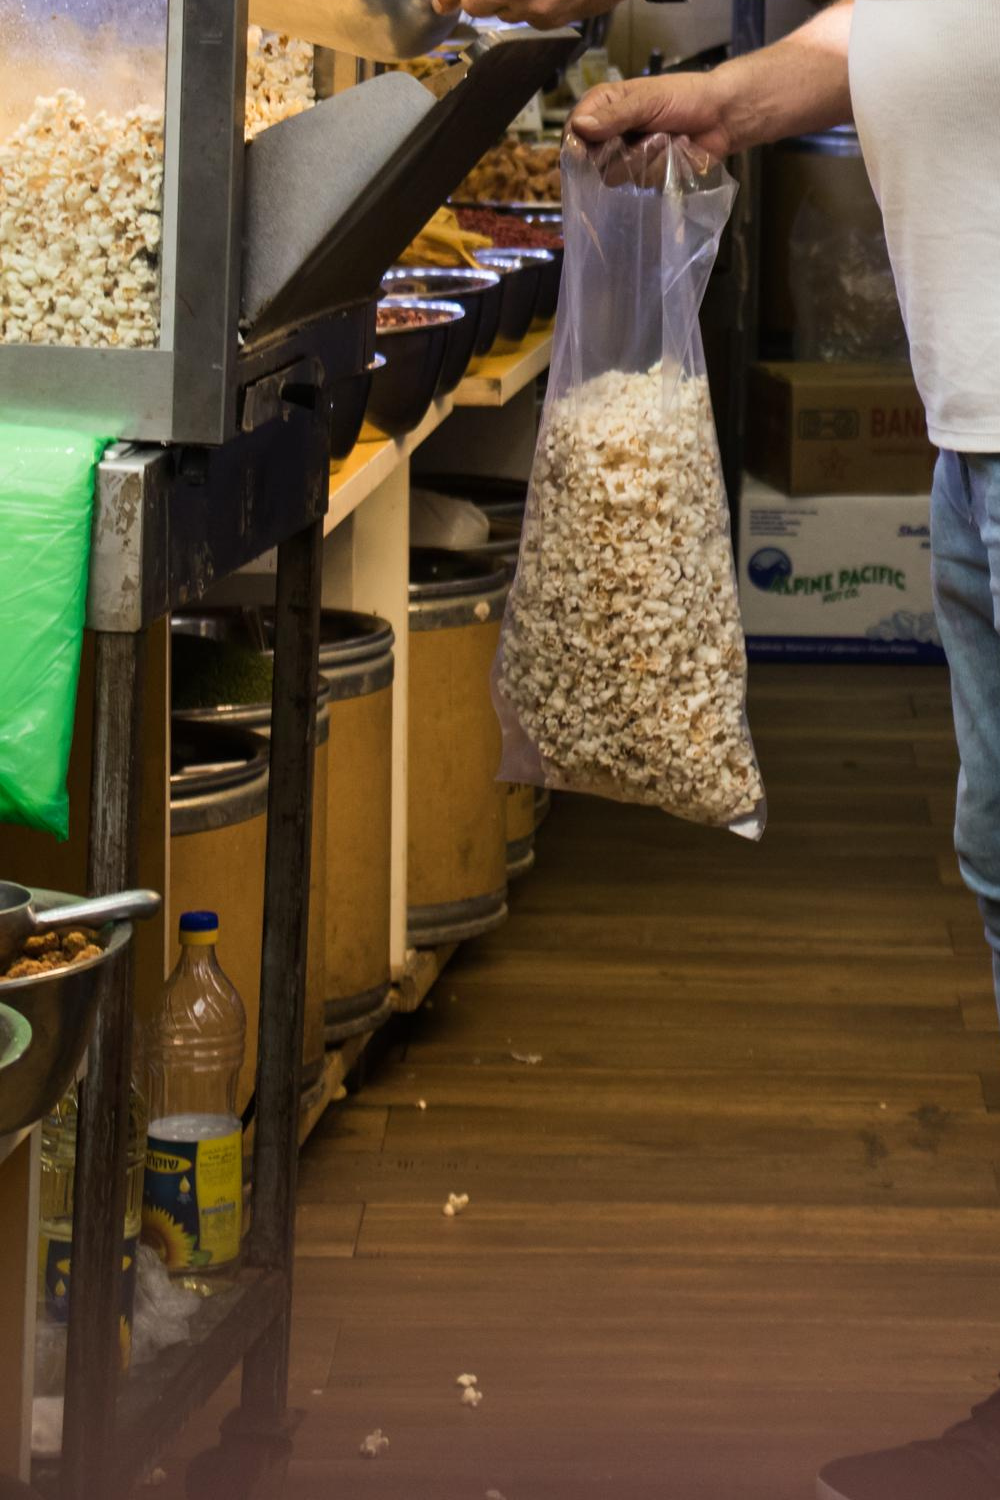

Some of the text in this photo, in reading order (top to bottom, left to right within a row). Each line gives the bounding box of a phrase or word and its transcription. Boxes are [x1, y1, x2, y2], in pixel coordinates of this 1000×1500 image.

[871, 407, 922, 438] BAN
[769, 564, 906, 596] ALPINE PACIFIC
